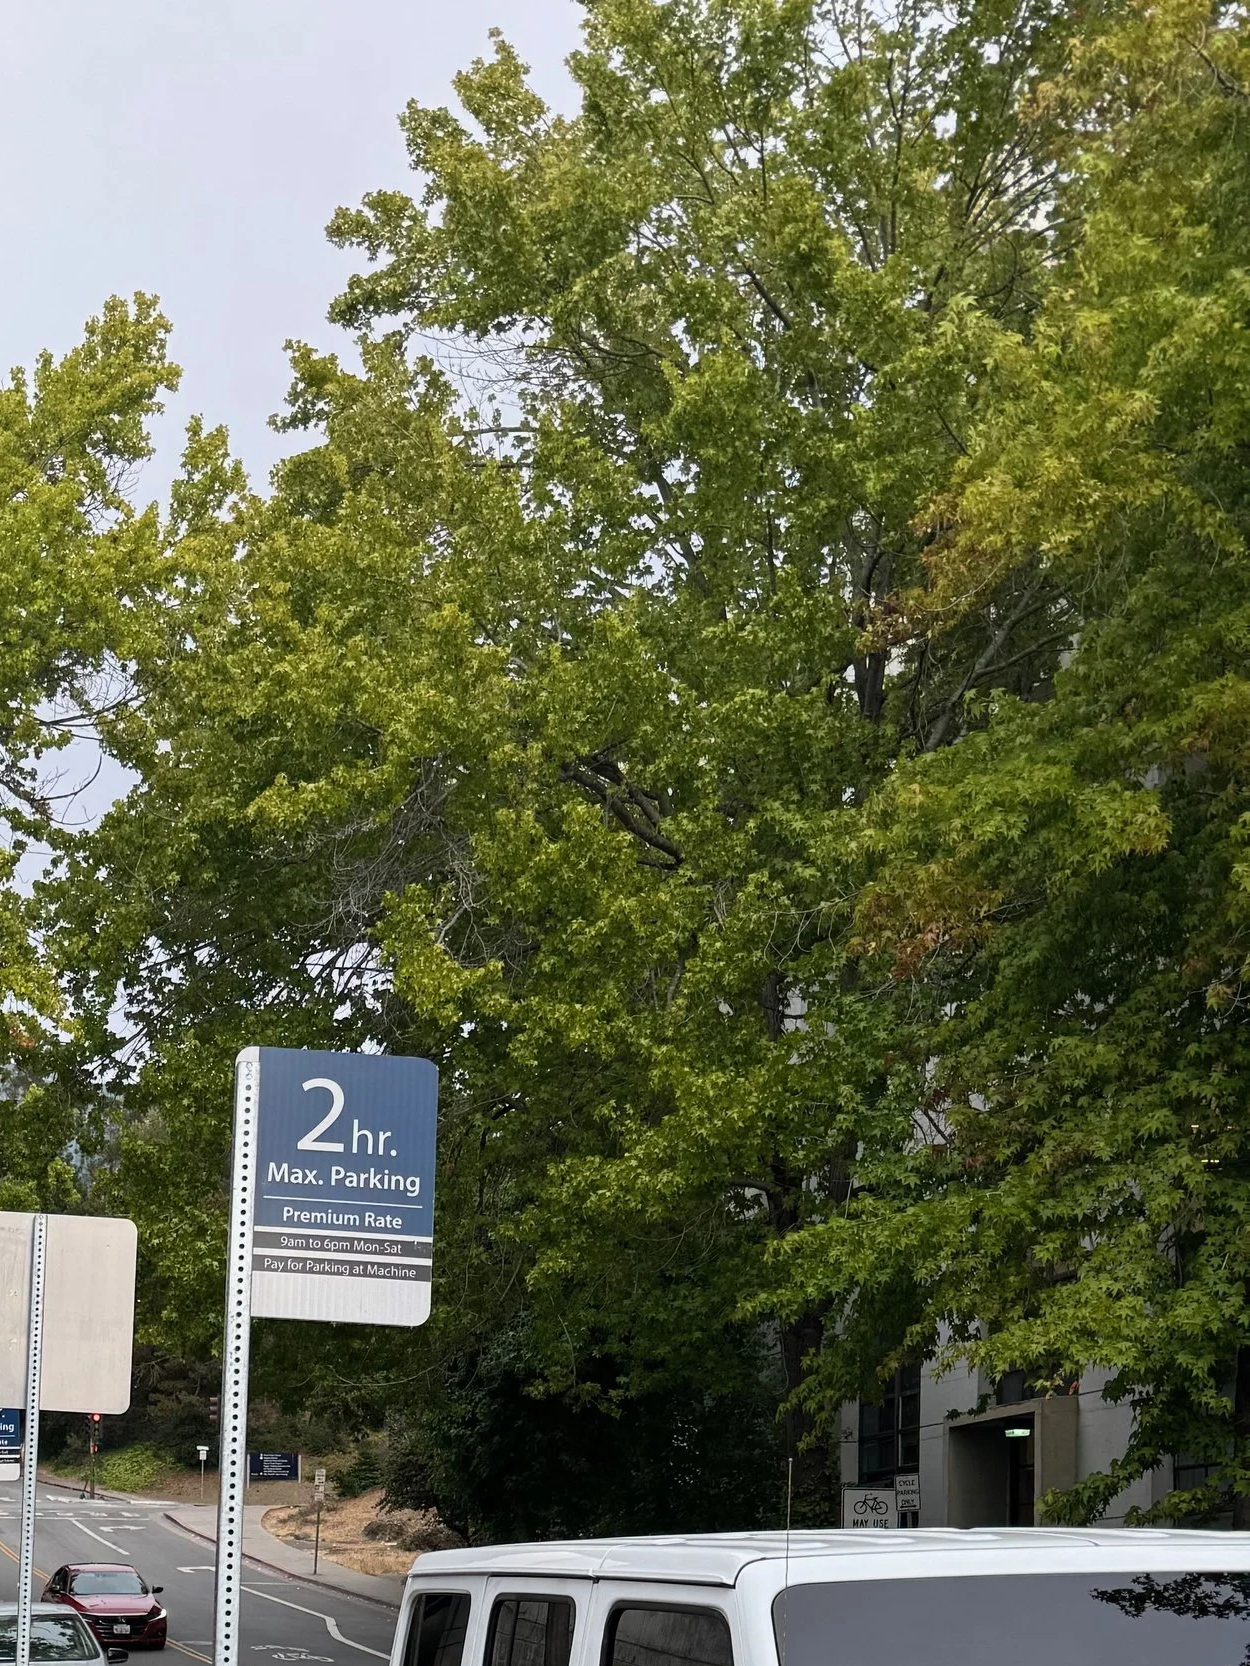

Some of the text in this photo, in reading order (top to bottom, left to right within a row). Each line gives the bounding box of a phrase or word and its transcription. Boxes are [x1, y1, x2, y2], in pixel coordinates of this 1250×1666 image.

[297, 1078, 397, 1157] 2 hr.
[267, 1162, 420, 1197] Max. Parking
[283, 1207, 402, 1229] Premium Rate
[280, 1236, 402, 1254] 9am to 6pm Mon-Sat
[264, 1258, 417, 1278] Pay for Parking at Machine
[852, 1519, 889, 1528] MAY USE
